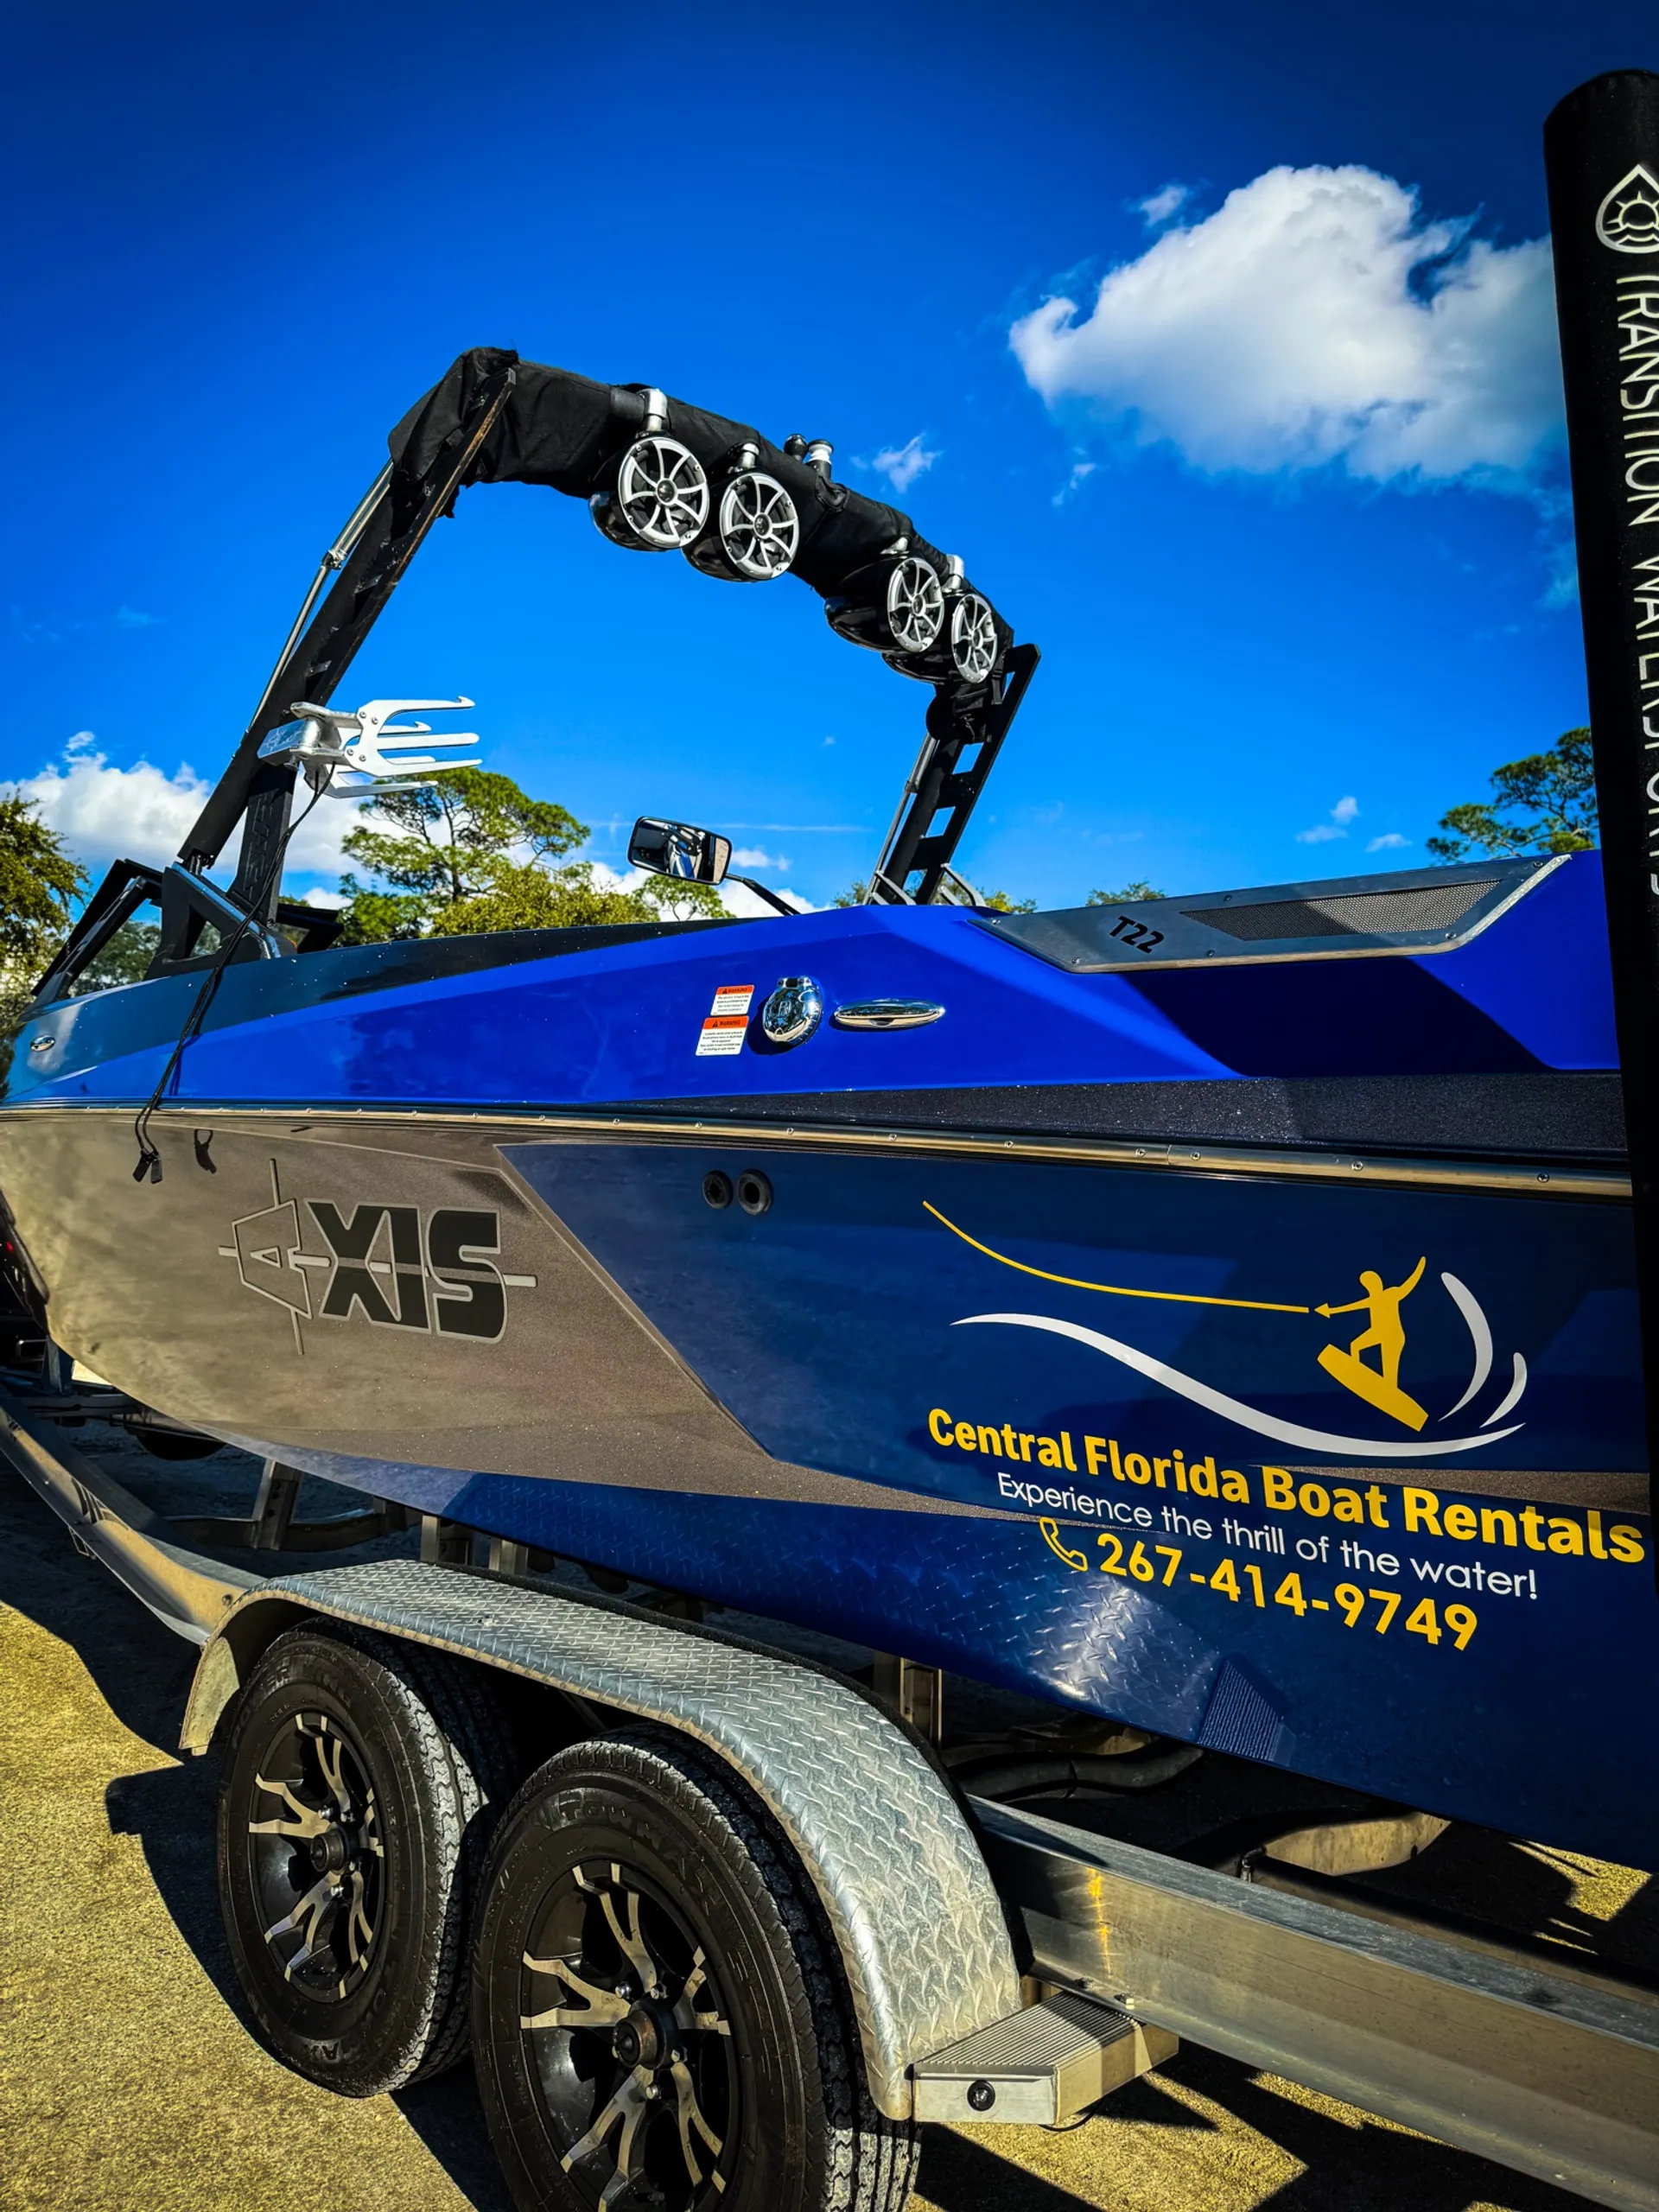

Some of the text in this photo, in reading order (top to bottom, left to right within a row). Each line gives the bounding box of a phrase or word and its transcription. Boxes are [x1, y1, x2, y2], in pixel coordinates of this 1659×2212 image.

[1109, 915, 1165, 954] T22
[928, 1408, 1646, 1563] Central Florida Boat Rentals
[997, 1471, 1538, 1600] Experience the thrill of the water!
[1096, 1533, 1478, 1652] 267-414-9749
